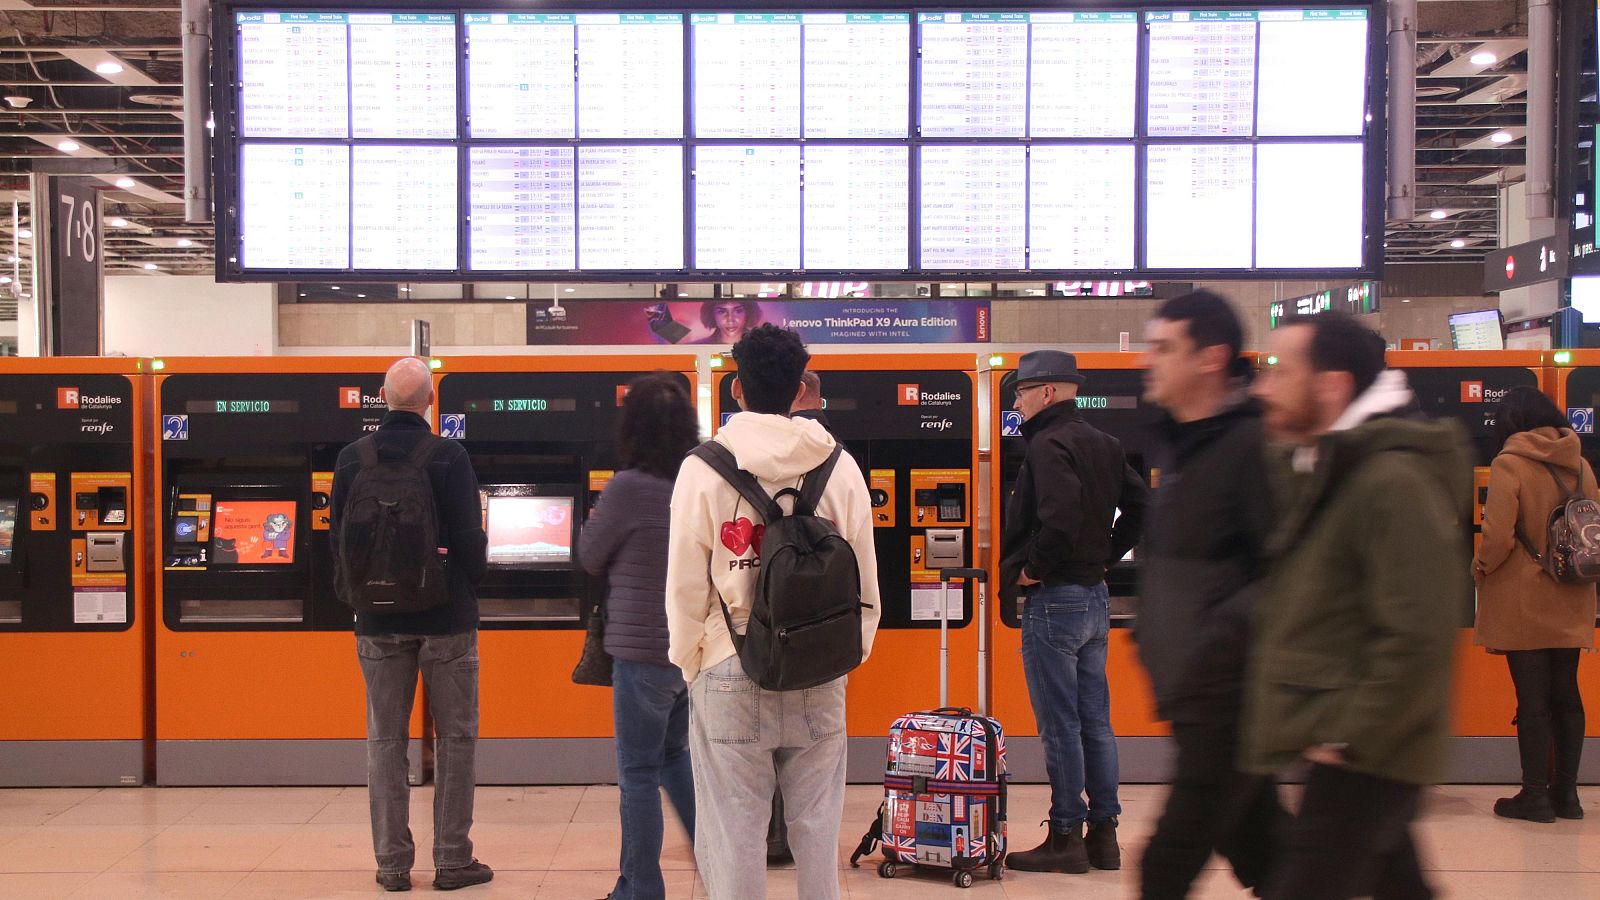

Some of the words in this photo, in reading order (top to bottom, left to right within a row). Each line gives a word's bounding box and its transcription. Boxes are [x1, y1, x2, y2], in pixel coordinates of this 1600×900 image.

[783, 317, 822, 327] Lenovo
[824, 317, 874, 327] ThinkPad
[876, 318, 891, 327] X9
[895, 318, 918, 327] Aura
[920, 317, 957, 327] Edition
[978, 310, 986, 339] Lenovo
[66, 390, 79, 404] R
[348, 390, 360, 403] R
[906, 387, 918, 401] R
[921, 392, 961, 400] Rodalies
[1468, 384, 1482, 398] R
[81, 396, 122, 404] Rodalies
[217, 401, 227, 412] EN
[231, 401, 270, 412] SERVICIO
[494, 400, 504, 411] EN
[508, 400, 547, 411] SERVICIO
[81, 422, 114, 435] renfe
[920, 418, 953, 432] renfe
